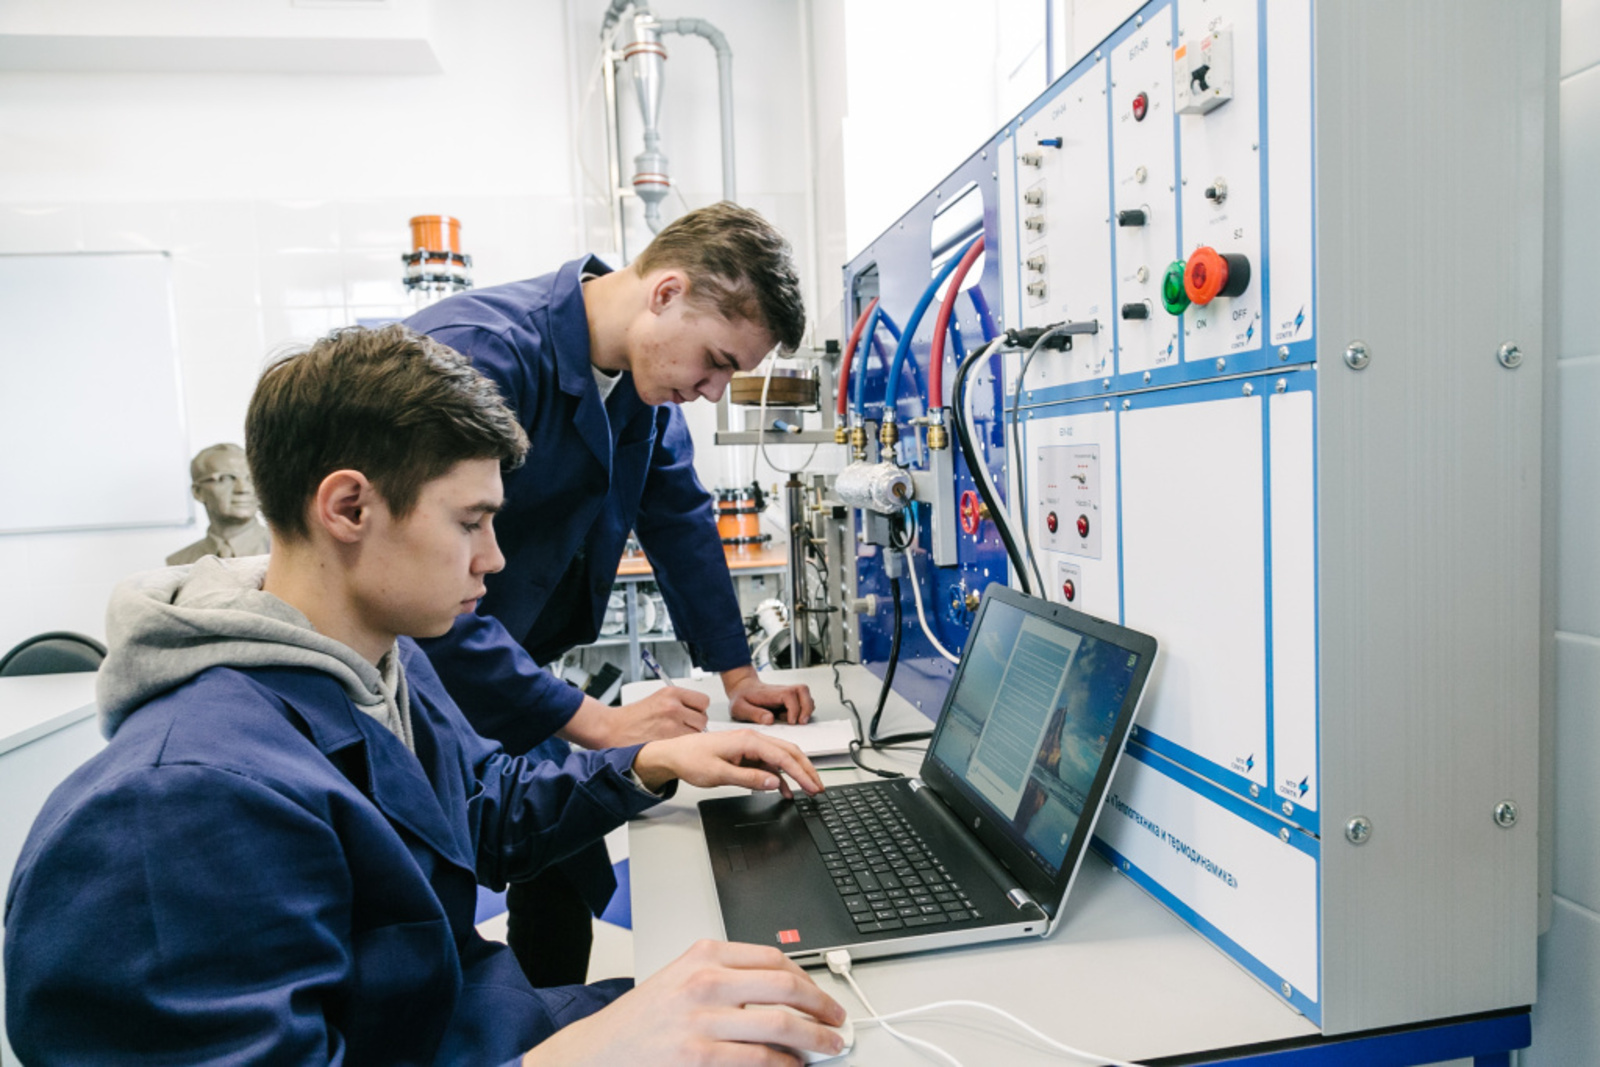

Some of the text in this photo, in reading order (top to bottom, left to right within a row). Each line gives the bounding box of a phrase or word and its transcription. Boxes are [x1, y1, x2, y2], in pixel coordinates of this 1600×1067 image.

[1231, 309, 1248, 322] OFF
[1196, 318, 1207, 330] ON
[1160, 828, 1167, 842] и
